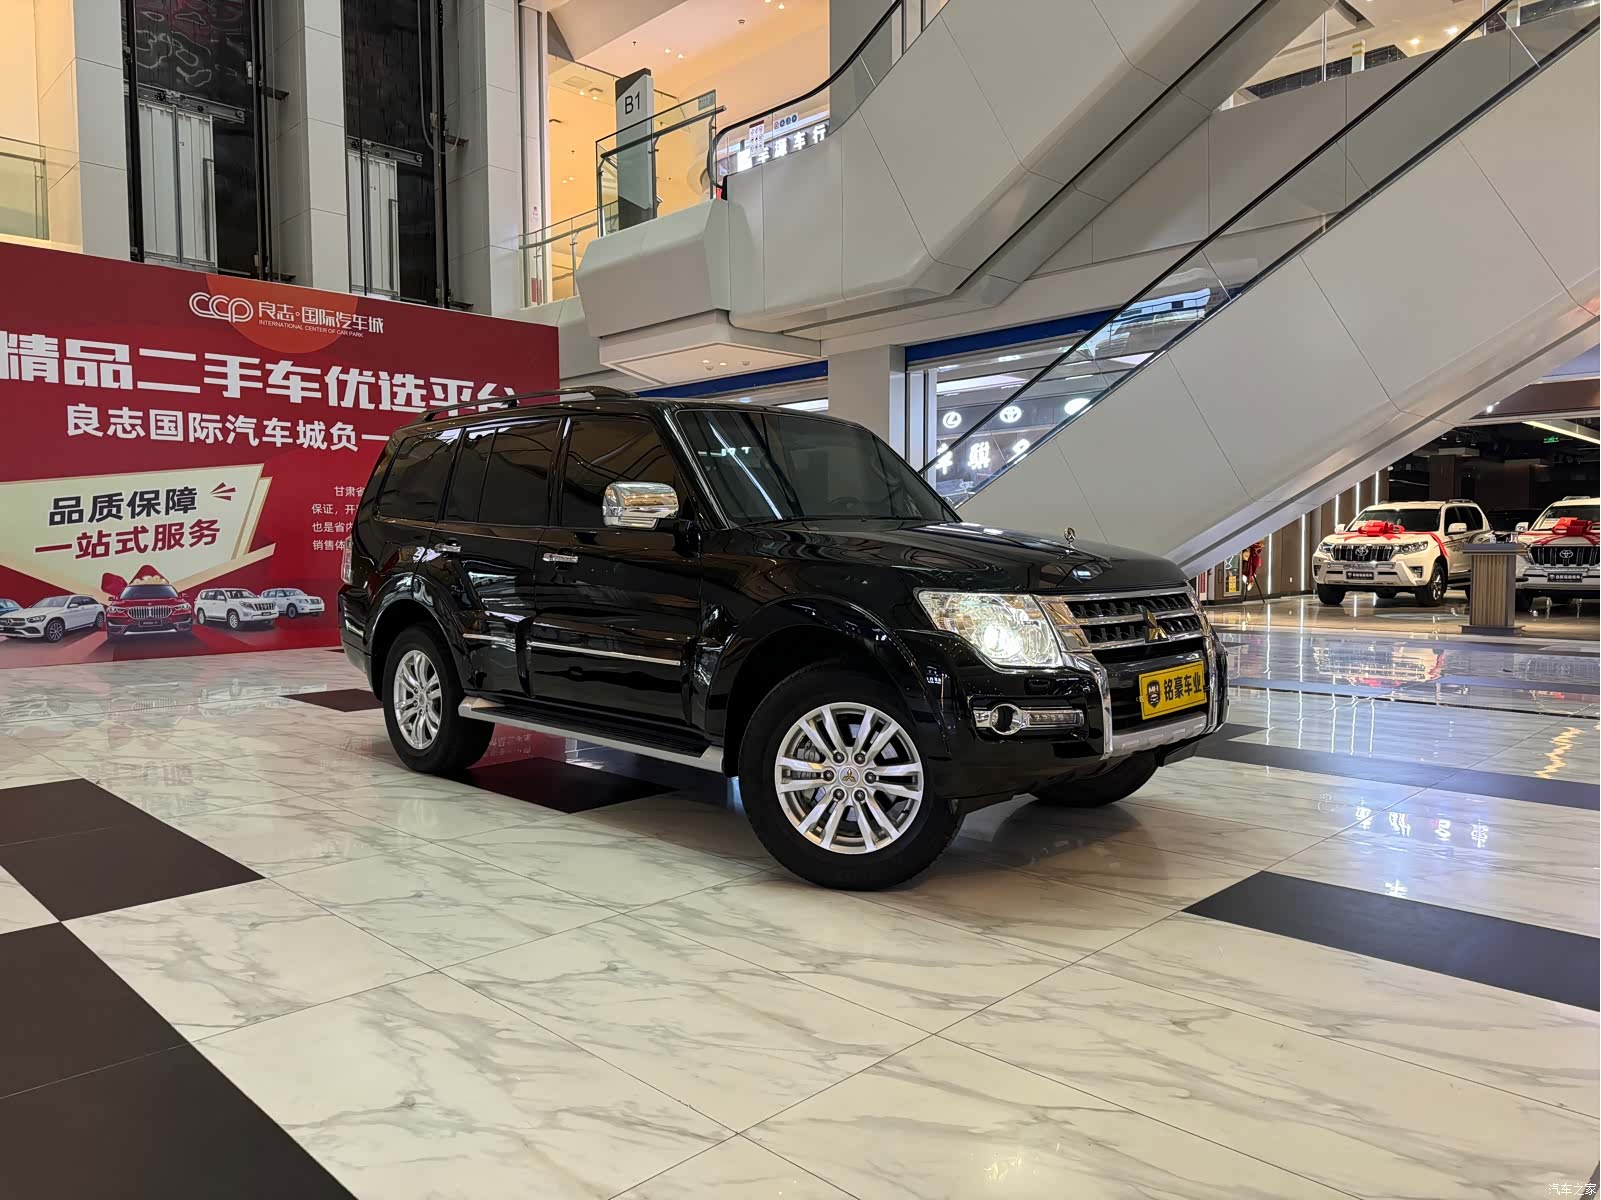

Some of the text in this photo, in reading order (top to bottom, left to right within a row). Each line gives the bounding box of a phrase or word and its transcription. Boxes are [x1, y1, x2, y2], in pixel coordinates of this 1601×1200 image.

[624, 91, 640, 115] B1
[258, 319, 304, 331] INTERNATIONAL
[304, 325, 327, 334] CENTER
[66, 403, 390, 452] 良志国际汽车城负一
[333, 485, 365, 497] 甘肃省
[49, 486, 198, 527] 品质保障
[311, 503, 359, 515] 保证，开
[312, 521, 353, 533] 也是省内
[35, 518, 221, 560] 一站式服务
[312, 539, 345, 551] 销售体
[1163, 671, 1202, 702] 铭豪车业
